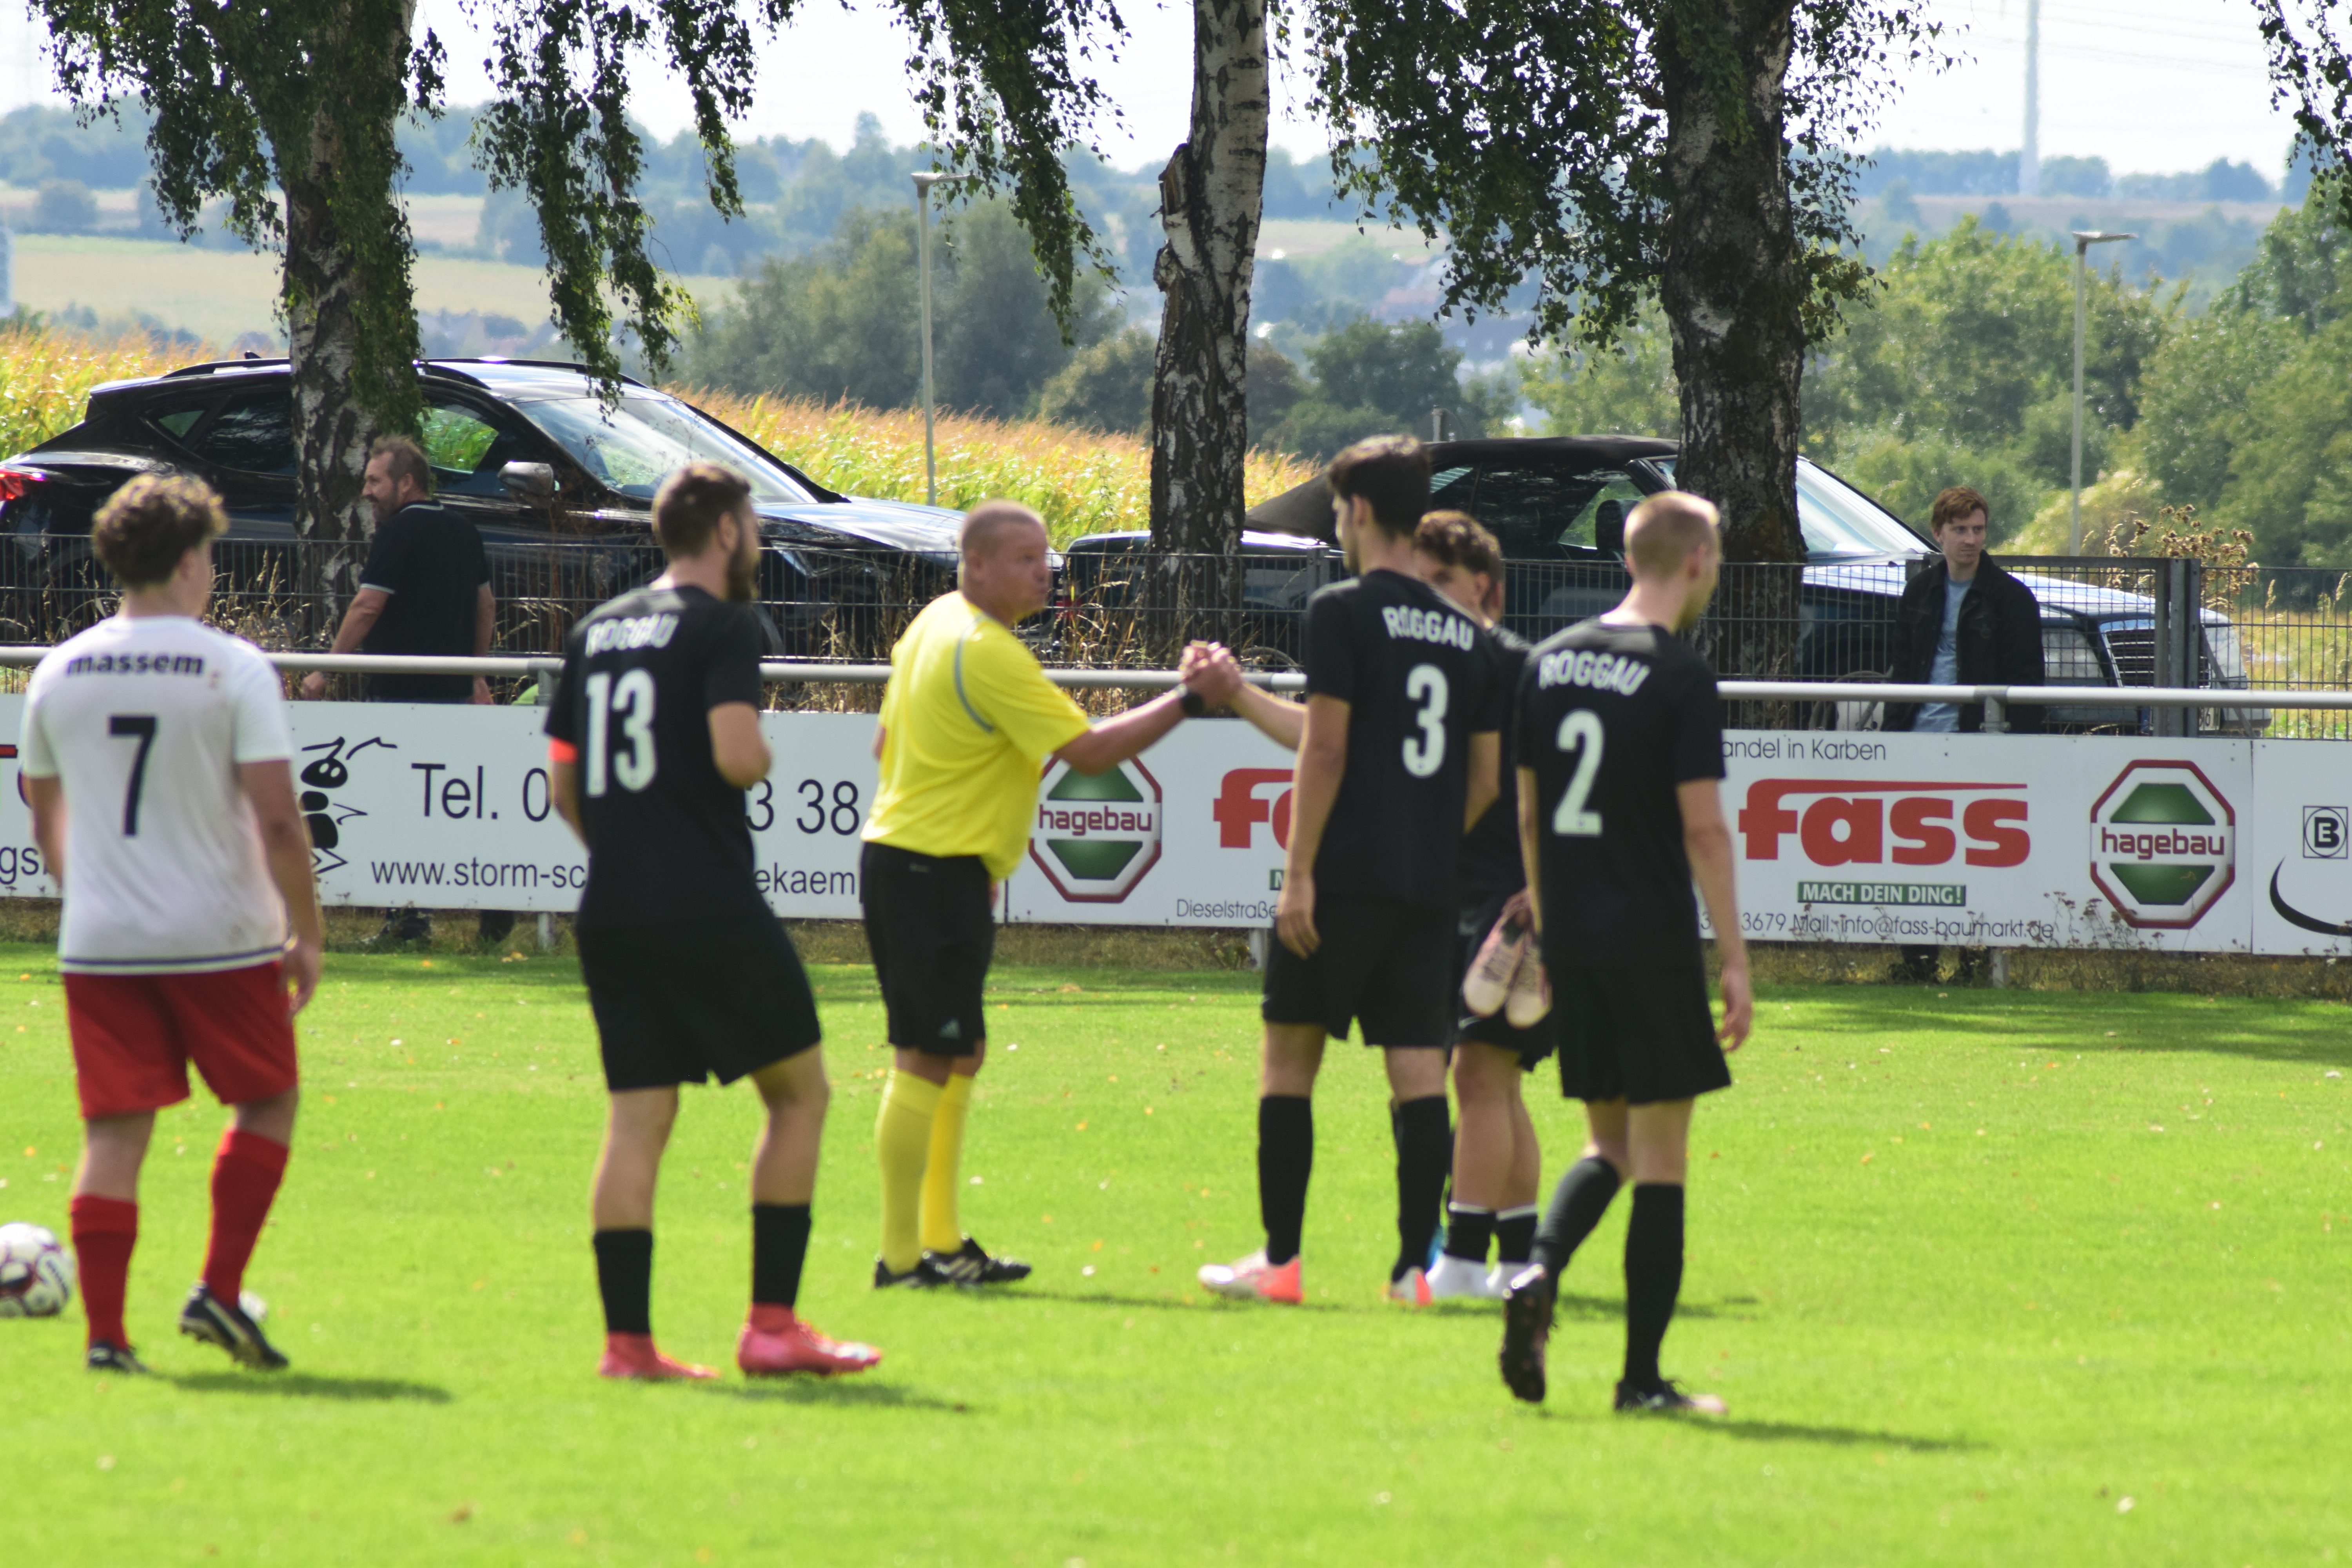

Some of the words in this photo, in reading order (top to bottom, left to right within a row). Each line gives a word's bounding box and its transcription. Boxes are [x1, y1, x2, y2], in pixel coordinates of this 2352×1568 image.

[67, 652, 205, 677] massem
[1539, 650, 1650, 695] ROGGAU
[585, 668, 658, 798] 13
[1403, 663, 1449, 778] 3
[1553, 709, 1604, 836] 2
[1788, 739, 1804, 759] in
[1812, 739, 1886, 760] Karben
[108, 716, 158, 837] 7
[411, 763, 498, 820] Tel.
[797, 779, 860, 835] 38
[1038, 804, 1152, 835] hagebau
[1739, 779, 2031, 867] fass
[2102, 827, 2224, 860] hagebau
[1803, 884, 1855, 901] MACH
[1861, 886, 1903, 902] DEIN
[1908, 887, 1961, 903] DING!
[1742, 912, 1786, 931] 3679
[1793, 914, 1833, 932] Mail:
[1841, 915, 2053, 938] info@fass-baumarkt.de
